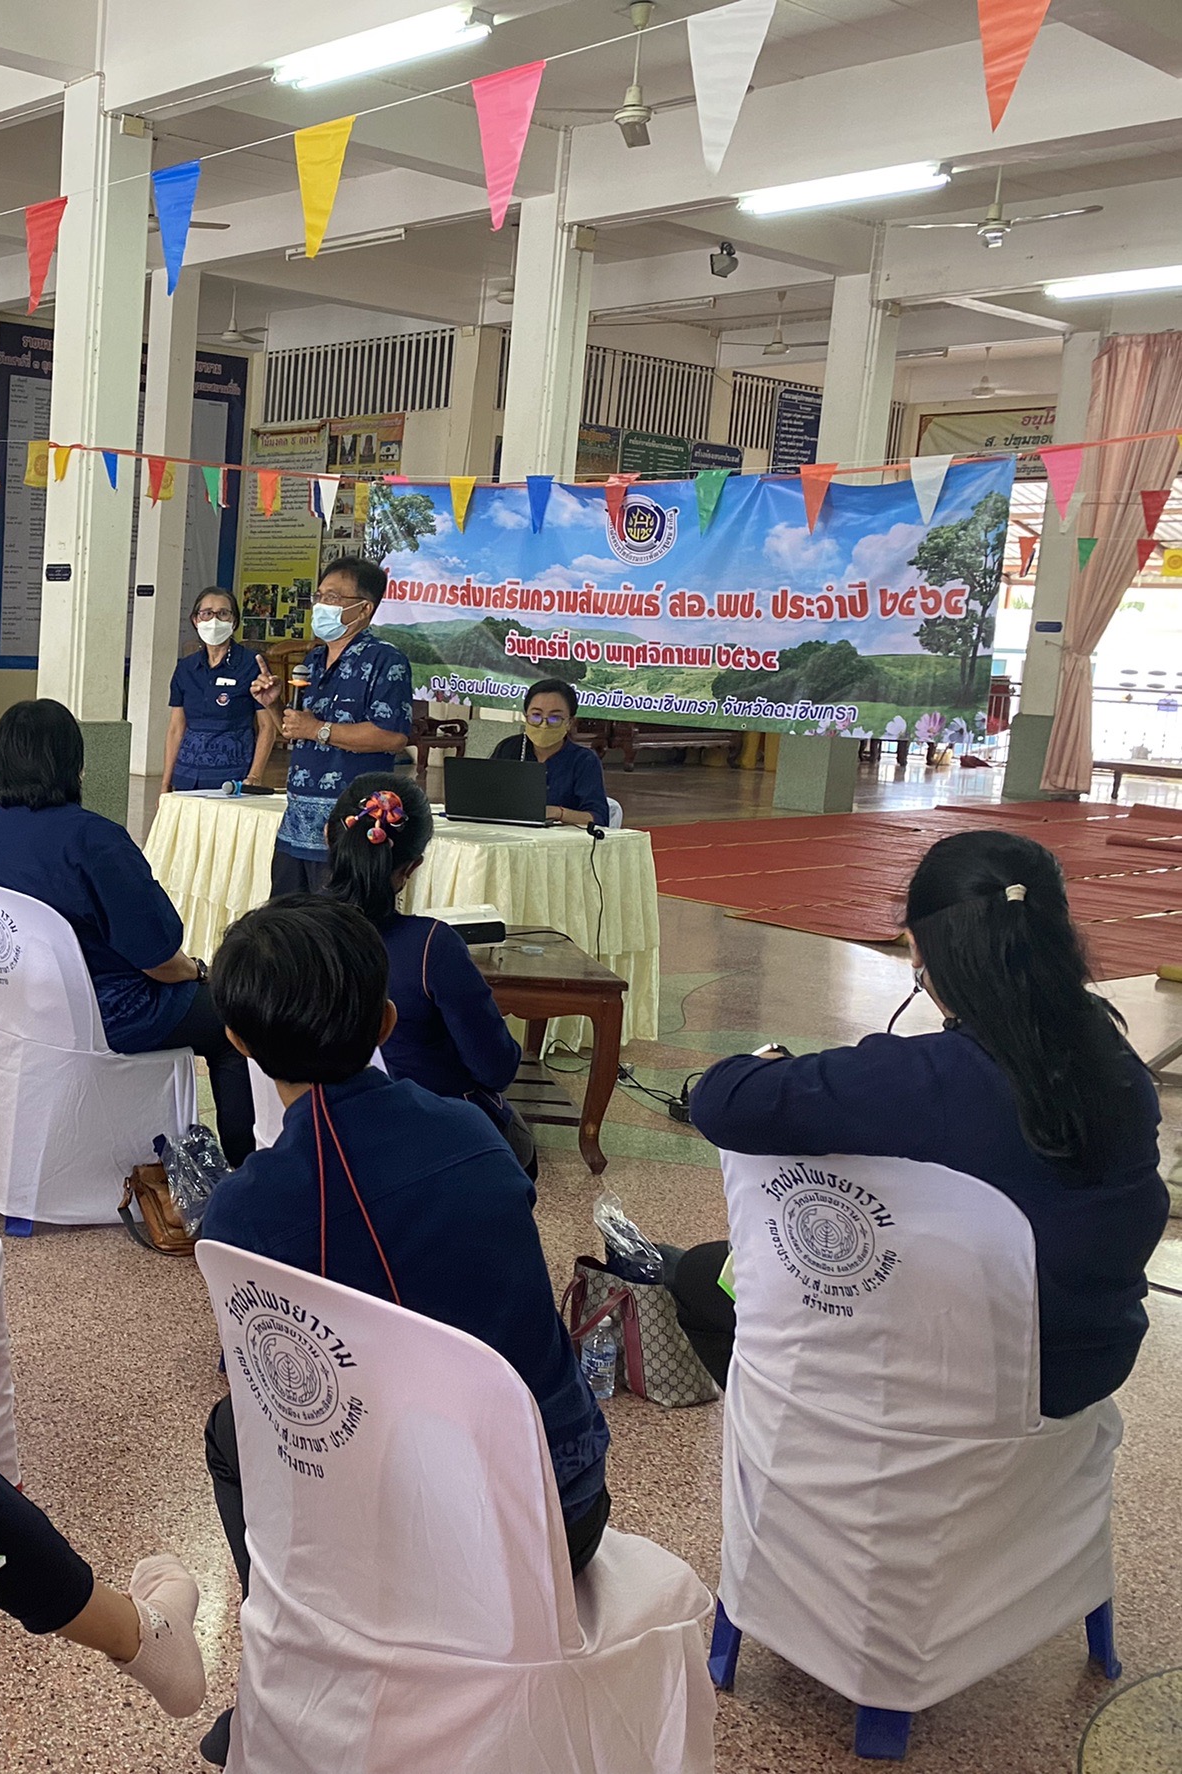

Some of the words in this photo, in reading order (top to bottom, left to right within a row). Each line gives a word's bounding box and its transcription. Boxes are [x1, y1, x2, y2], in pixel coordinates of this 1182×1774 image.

[668, 590, 762, 619] สอ.พช.
[772, 581, 870, 620] ประจำปี
[879, 586, 967, 616] ๒๕๖๔
[506, 631, 569, 661] วันศุกร์ที่
[574, 640, 601, 660] ๑๒
[606, 641, 711, 669] พฤศจิกายน
[717, 644, 778, 670] ๒๕๖๔
[432, 676, 447, 691] ณ
[450, 674, 528, 699] วัดชมโพธยา
[572, 684, 717, 714] ำเภอเมืองฉะเชิงเทรา
[722, 696, 857, 722] จังหวัดฉะเชิงเทรา
